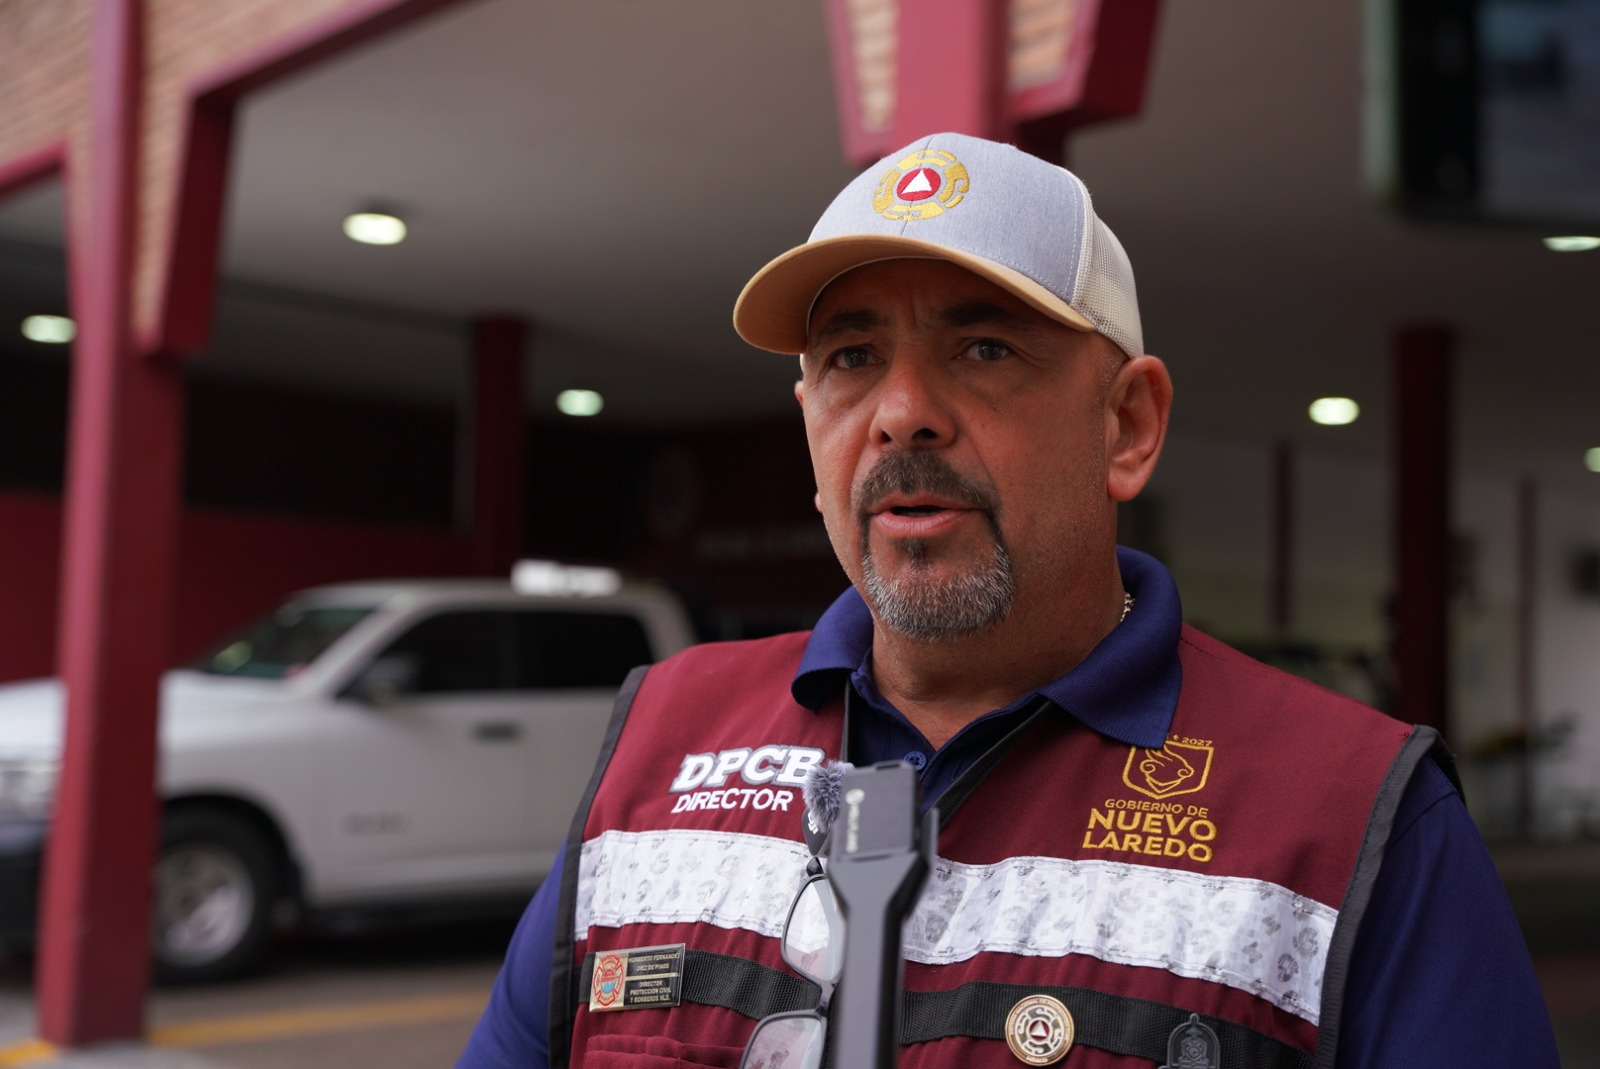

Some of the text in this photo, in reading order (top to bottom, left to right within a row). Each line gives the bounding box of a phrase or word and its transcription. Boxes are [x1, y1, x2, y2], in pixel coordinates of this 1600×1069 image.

[1181, 736, 1213, 747] 2027
[669, 744, 825, 793] DPCB
[671, 788, 793, 814] DIRECTOR
[1104, 798, 1209, 819] GOBIERNO DE
[1087, 808, 1217, 841] NUEVO
[1082, 831, 1213, 862] LAREDO
